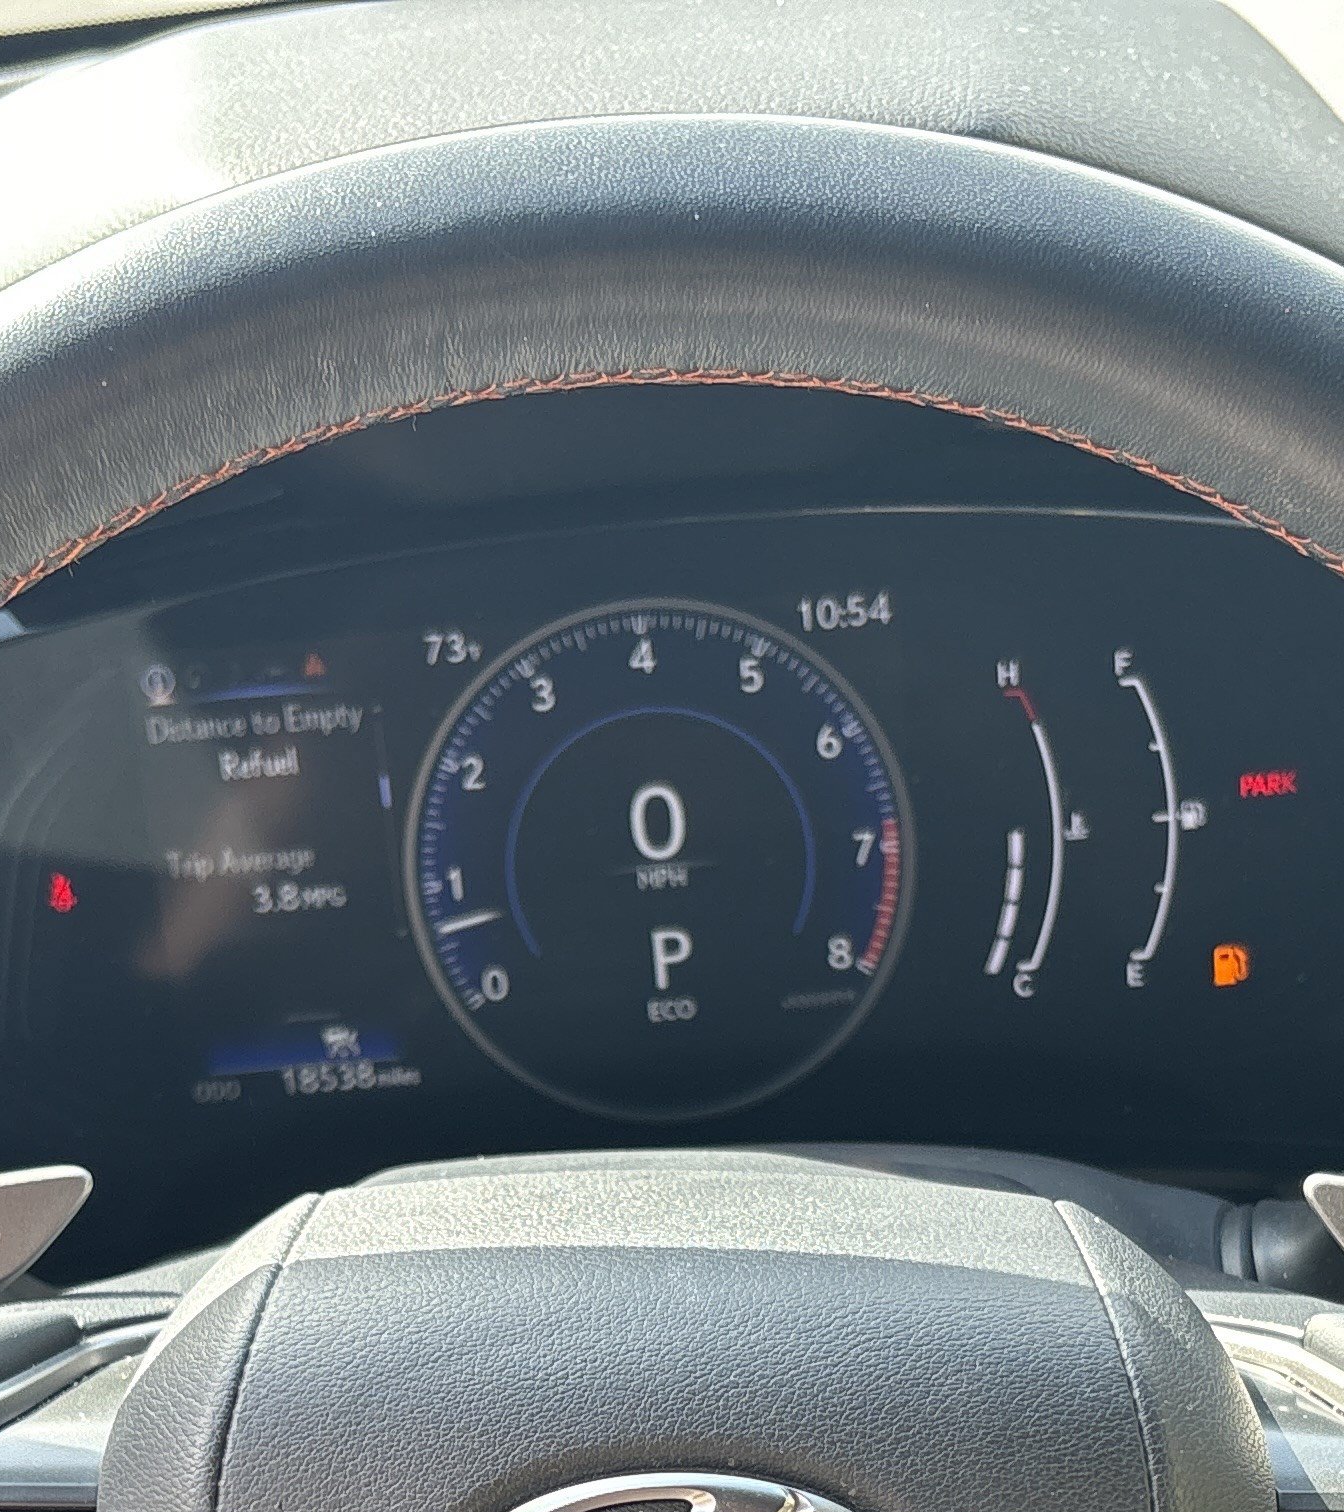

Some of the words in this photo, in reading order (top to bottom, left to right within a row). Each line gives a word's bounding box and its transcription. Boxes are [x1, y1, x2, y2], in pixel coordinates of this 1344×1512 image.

[798, 591, 892, 631] 10:54
[629, 640, 654, 673] 4
[1114, 649, 1133, 675] F
[740, 659, 763, 692] 5
[997, 660, 1019, 687] H
[530, 675, 554, 711] 3
[817, 725, 841, 759] 6
[463, 758, 486, 790] 2
[1239, 771, 1297, 798] PARK
[630, 784, 685, 860] 0
[854, 833, 874, 866] 7
[447, 867, 463, 900] 1
[651, 928, 692, 989] P
[828, 935, 852, 970] 8
[481, 965, 509, 1000] 0
[1013, 973, 1035, 997] C
[1126, 962, 1144, 987] E
[647, 998, 697, 1023] ECO
